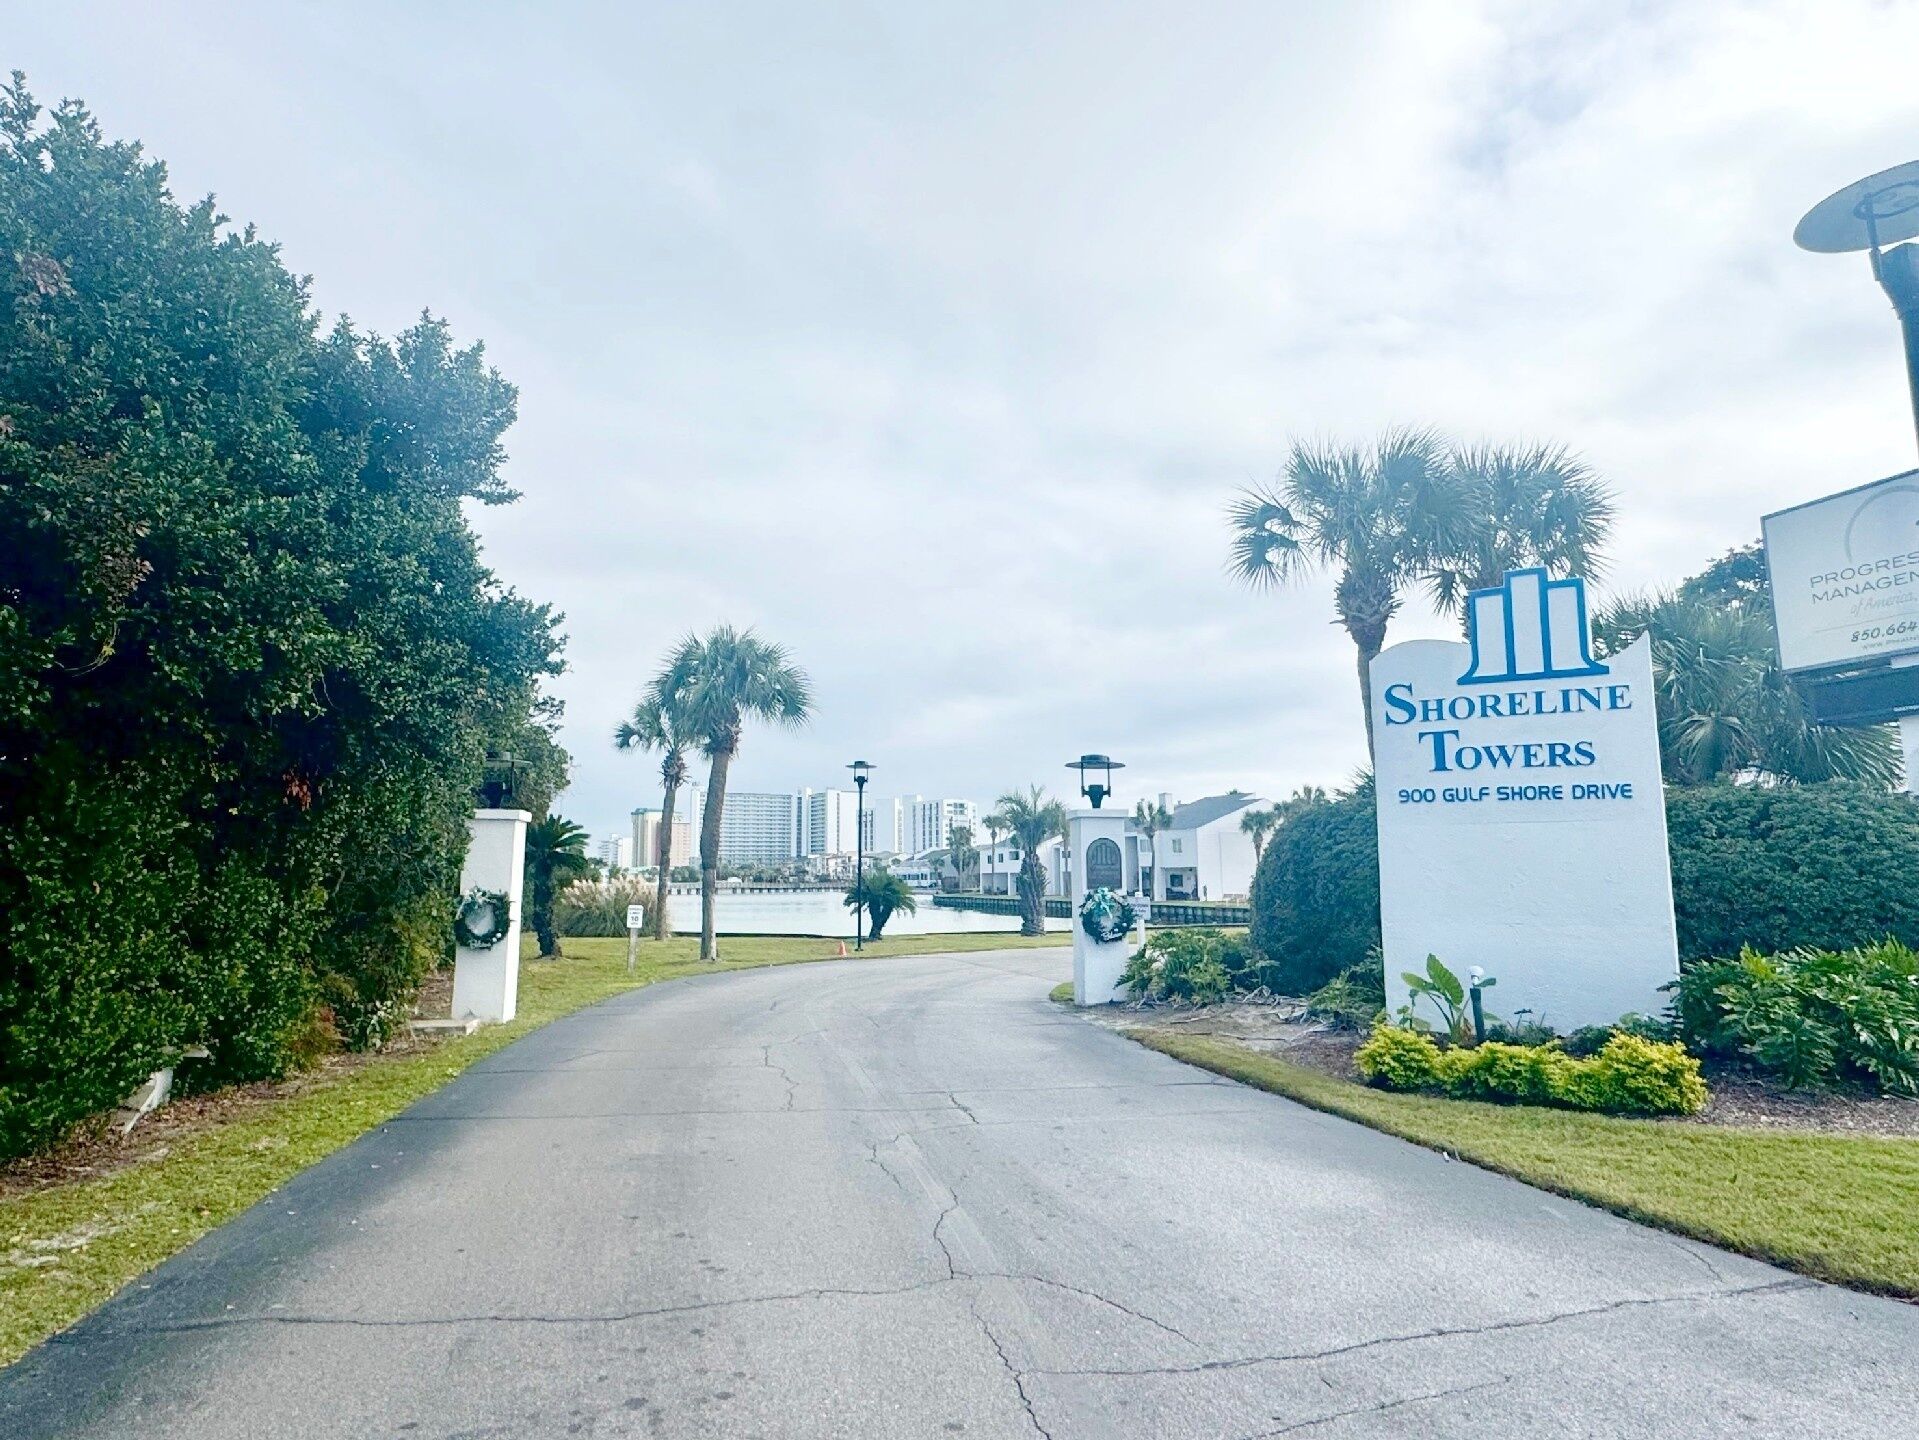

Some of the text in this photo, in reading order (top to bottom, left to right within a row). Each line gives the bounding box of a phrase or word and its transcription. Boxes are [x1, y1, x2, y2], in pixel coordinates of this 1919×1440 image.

[1384, 683, 1632, 726] SHORELINE
[1418, 729, 1596, 773] TOWERS
[1398, 783, 1633, 804] 900 GULF SHORE DRIVE
